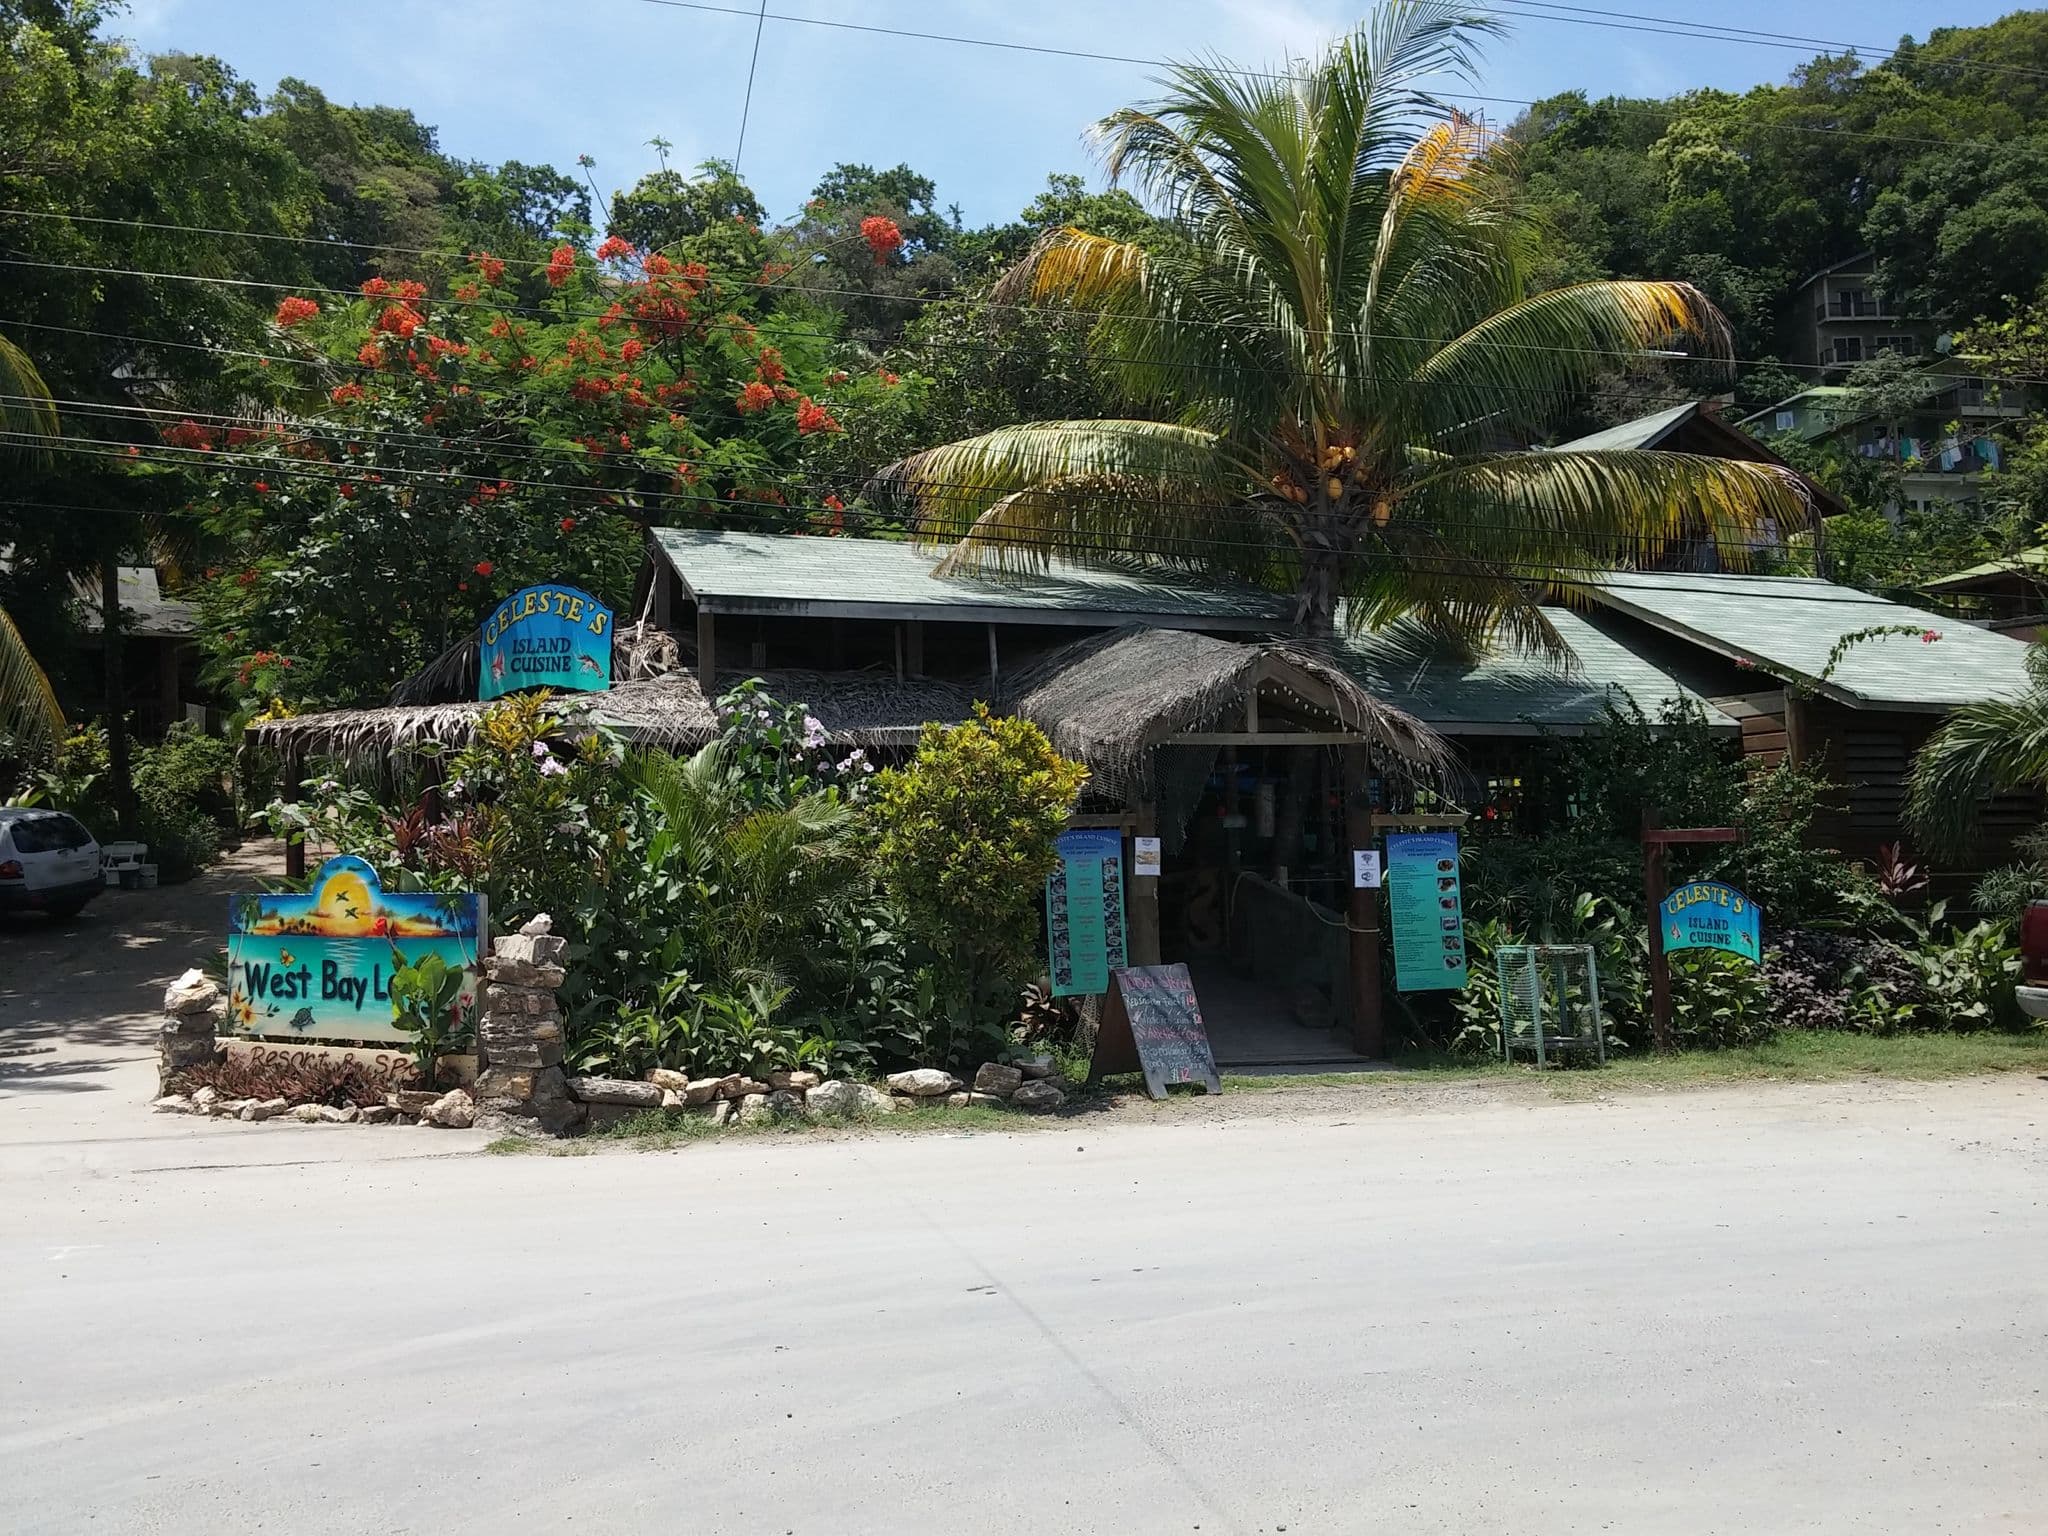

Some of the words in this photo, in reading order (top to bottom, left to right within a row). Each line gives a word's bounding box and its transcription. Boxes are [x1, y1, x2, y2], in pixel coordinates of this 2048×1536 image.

[486, 590, 608, 646] CELESTE'S
[512, 637, 571, 654] ISLAND
[510, 655, 571, 673] CUISINE
[1667, 885, 1744, 914] CELESTE'S
[1688, 917, 1729, 930] ISLAND
[1689, 932, 1731, 945] CUISINE
[244, 961, 313, 999] West
[321, 959, 369, 1012] Bay
[249, 1046, 329, 1068] Resort
